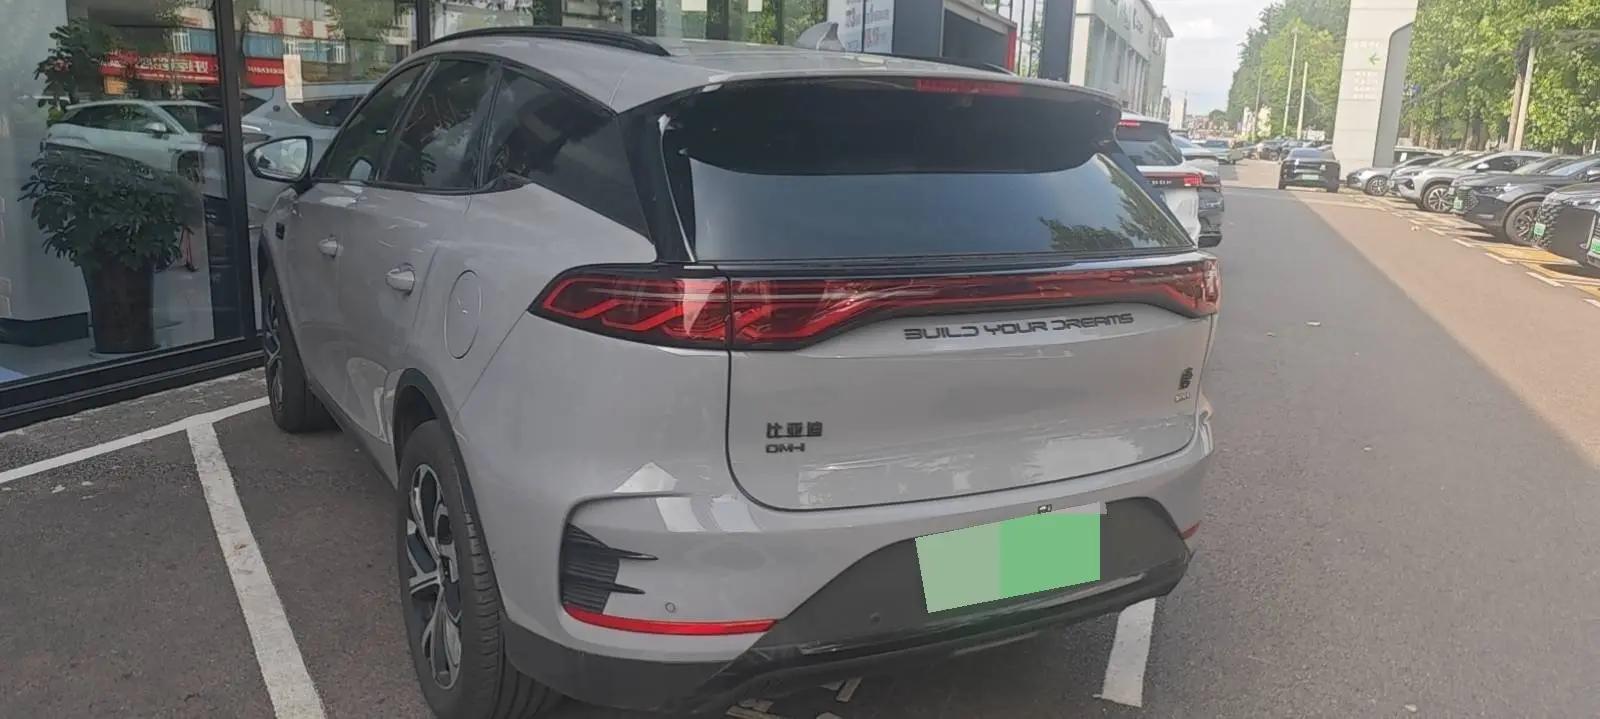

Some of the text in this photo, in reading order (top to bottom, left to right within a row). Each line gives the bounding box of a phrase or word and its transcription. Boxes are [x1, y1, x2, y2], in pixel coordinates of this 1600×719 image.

[904, 313, 1134, 340] BUILD YOUR DREAMS
[766, 421, 822, 438] 比亚迪
